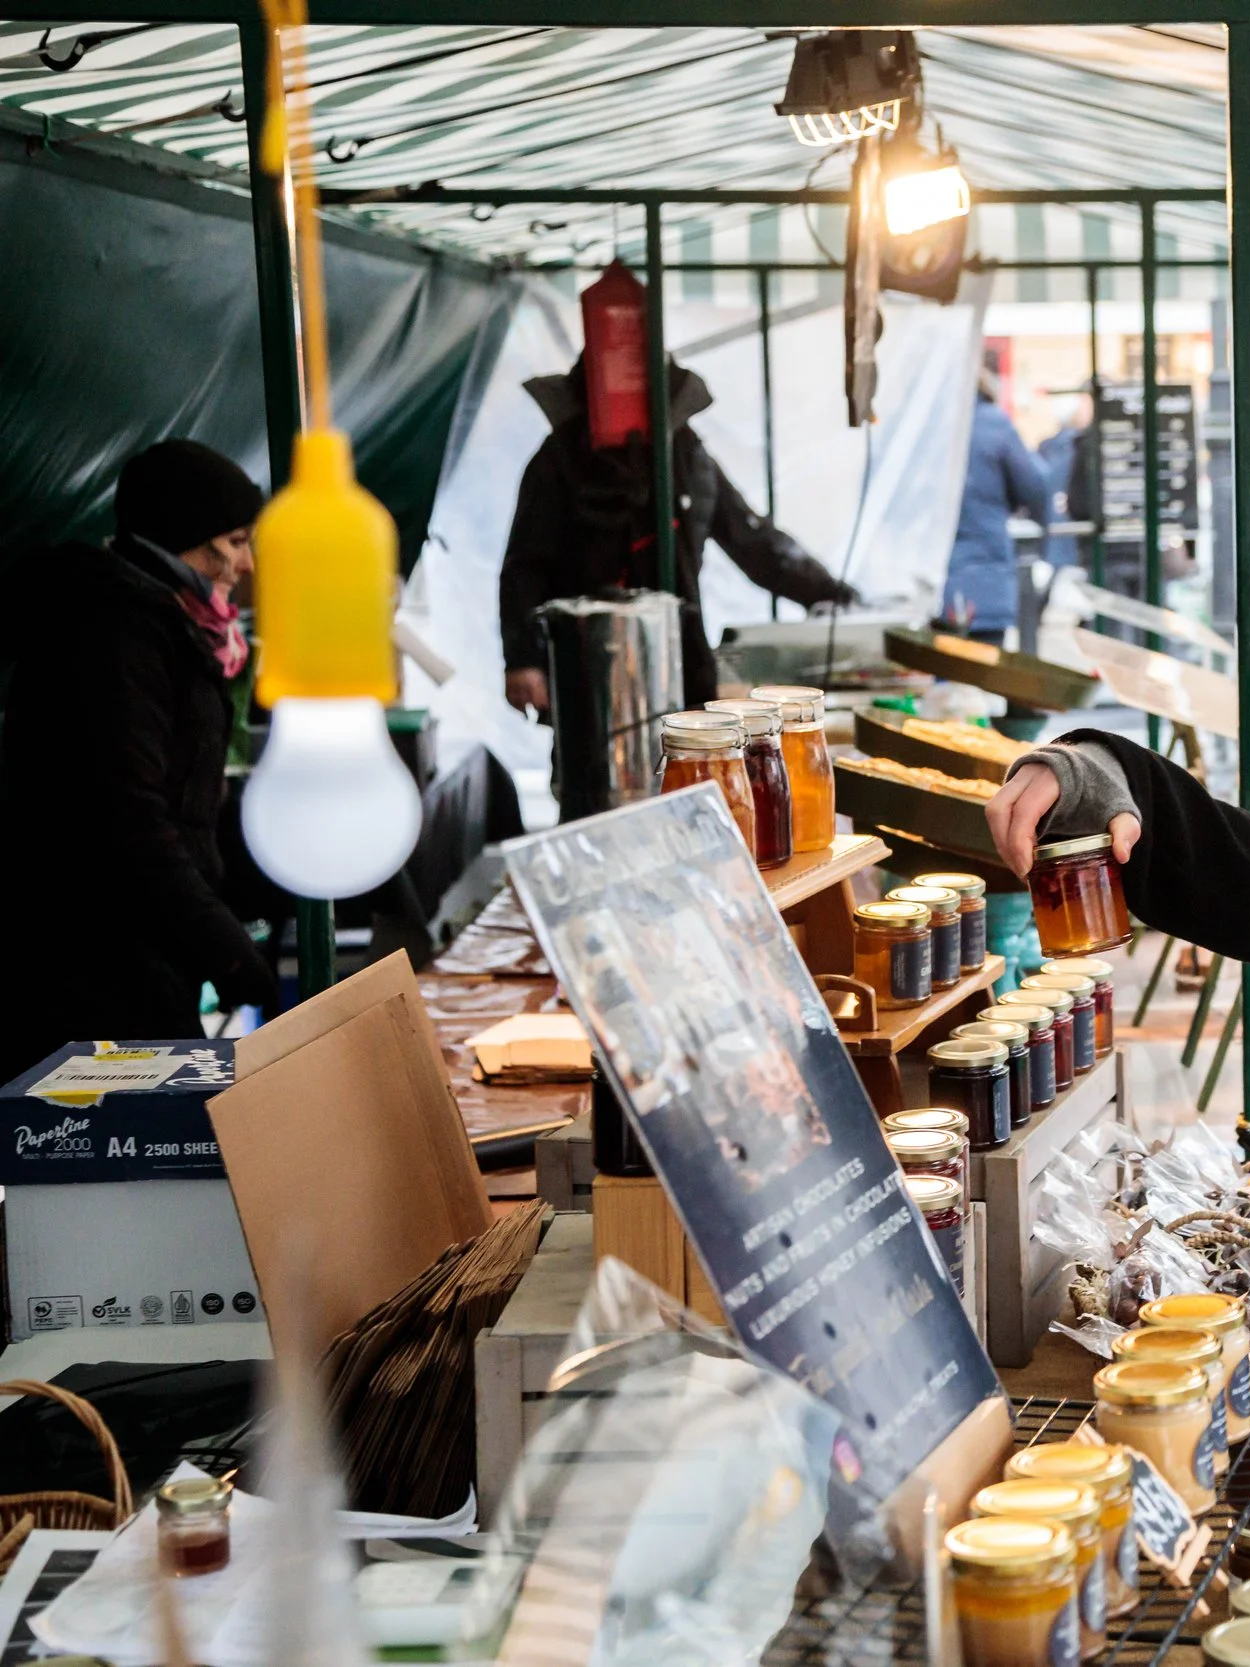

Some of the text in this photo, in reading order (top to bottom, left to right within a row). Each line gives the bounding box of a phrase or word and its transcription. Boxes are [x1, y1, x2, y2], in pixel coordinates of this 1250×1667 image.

[14, 1116, 91, 1155] Paperline
[53, 1138, 92, 1151] 2000
[107, 1136, 219, 1158] A4 2500 SHEE
[792, 1157, 866, 1216] CHOCOLATES
[856, 1205, 912, 1259] INFUSIONS
[724, 1272, 764, 1309] NUTS
[761, 1253, 792, 1283] AND
[107, 1306, 132, 1314] SVLK
